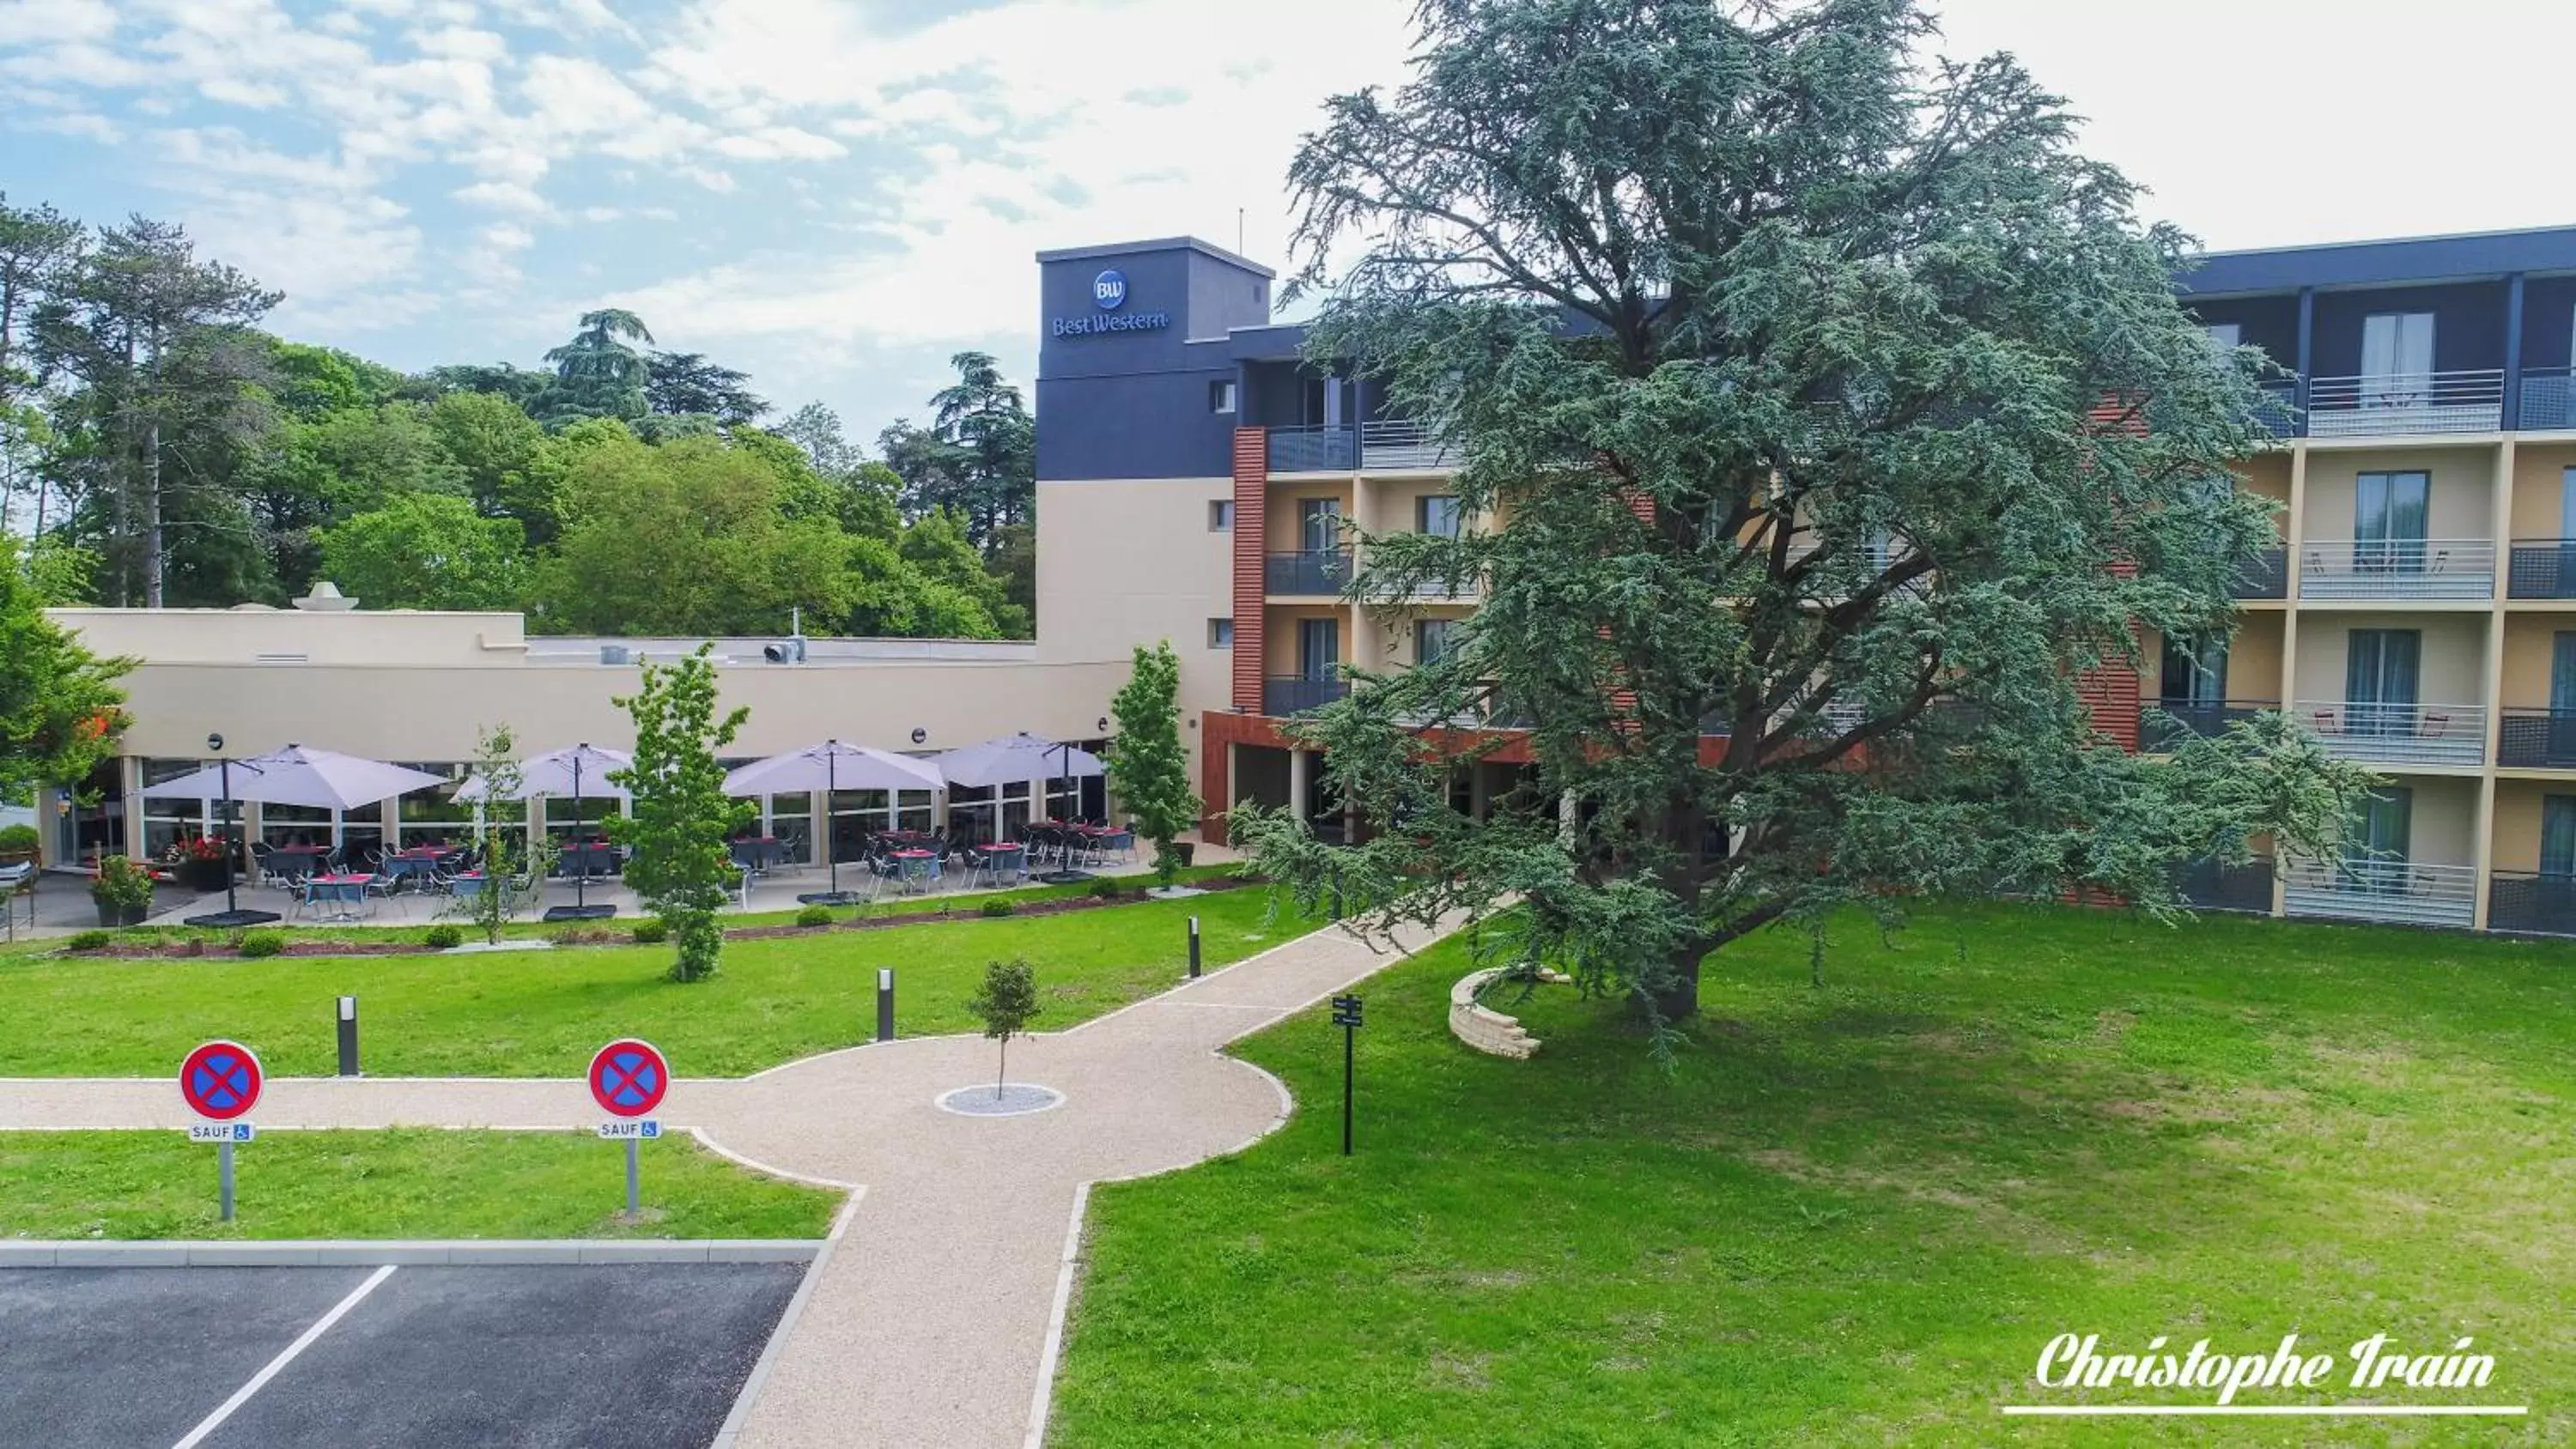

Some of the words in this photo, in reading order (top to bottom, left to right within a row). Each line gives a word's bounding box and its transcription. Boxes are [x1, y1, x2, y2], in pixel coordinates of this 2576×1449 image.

[1097, 282, 1121, 299] BW
[1053, 317, 1091, 336] Best
[1092, 312, 1168, 331] Western
[192, 1126, 230, 1138] SAUF
[602, 1124, 638, 1136] SAUF
